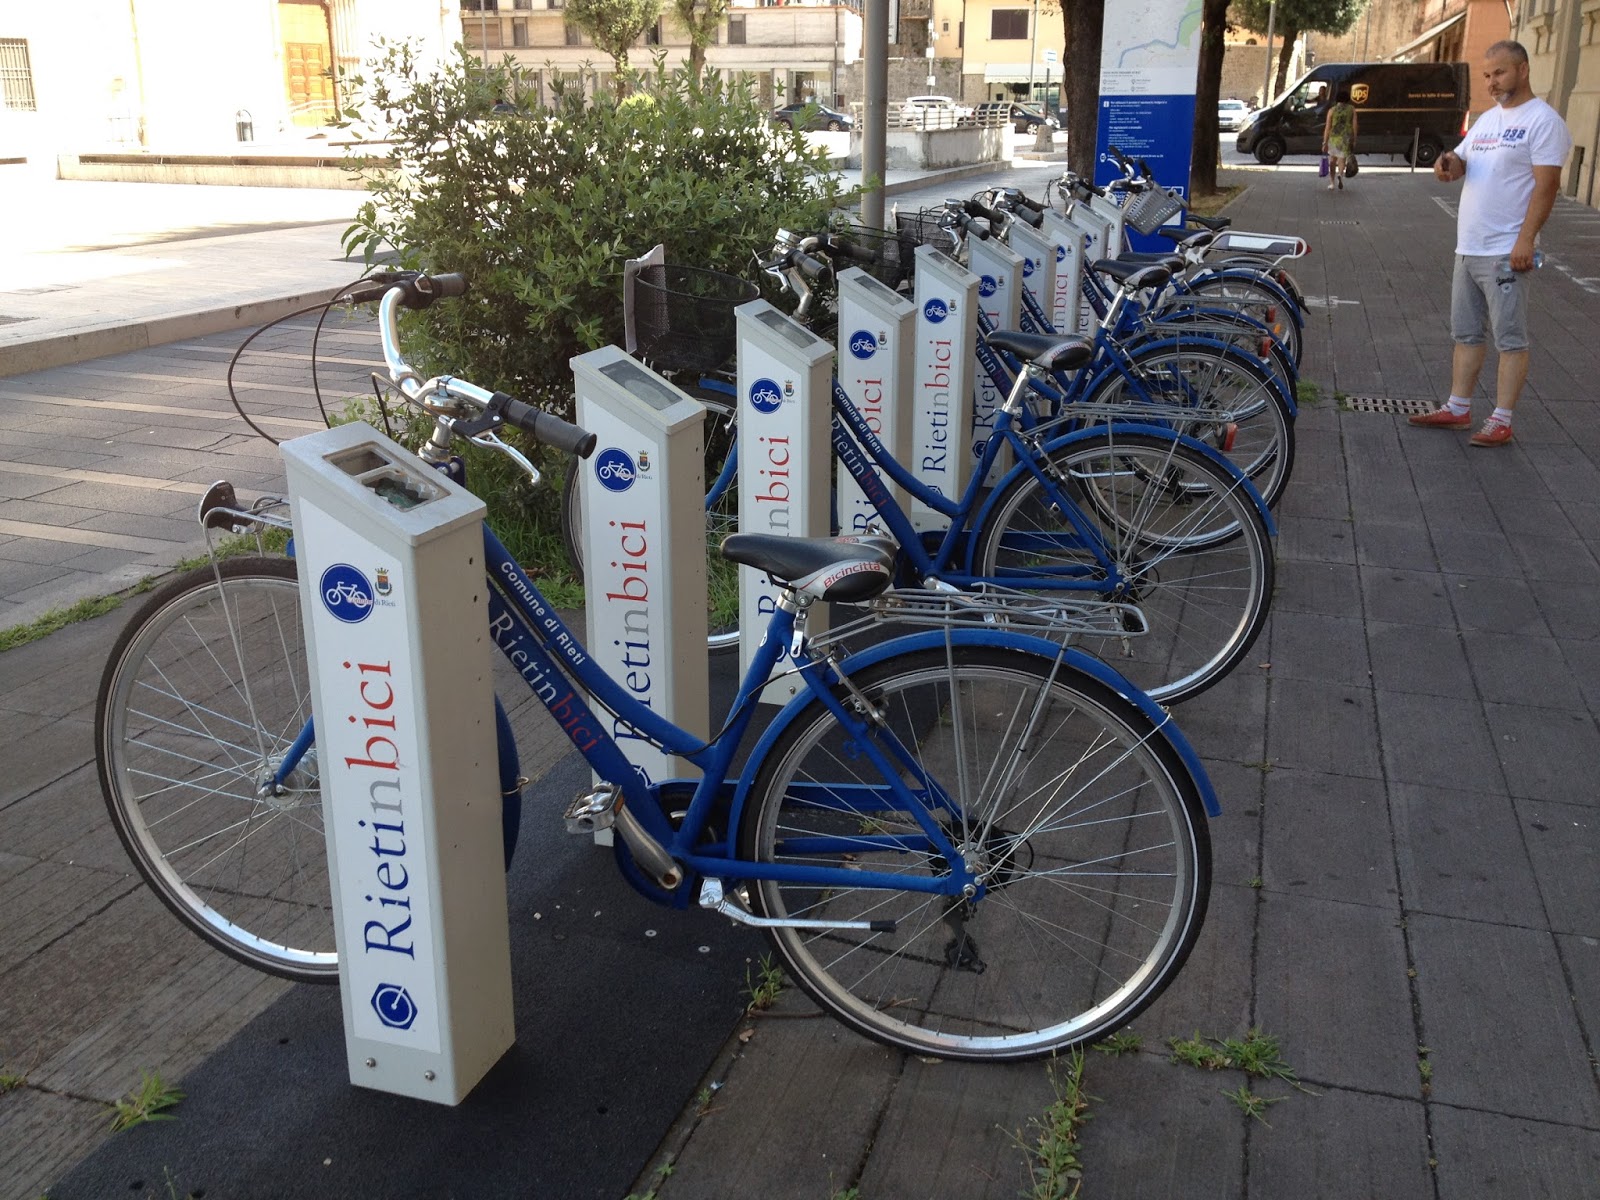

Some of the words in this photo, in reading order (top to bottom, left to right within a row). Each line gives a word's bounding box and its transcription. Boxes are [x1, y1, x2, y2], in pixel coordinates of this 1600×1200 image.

[1352, 89, 1367, 100] ups
[835, 387, 859, 422] Comune
[865, 432, 882, 454] Rieti
[923, 339, 952, 473] Rietinbici
[381, 599, 396, 607] Rieti
[501, 561, 545, 617] Comune
[544, 616, 560, 634] di
[556, 631, 586, 666] Rieti
[490, 609, 604, 752] Rietinbici
[343, 660, 415, 961] Rietinbici
